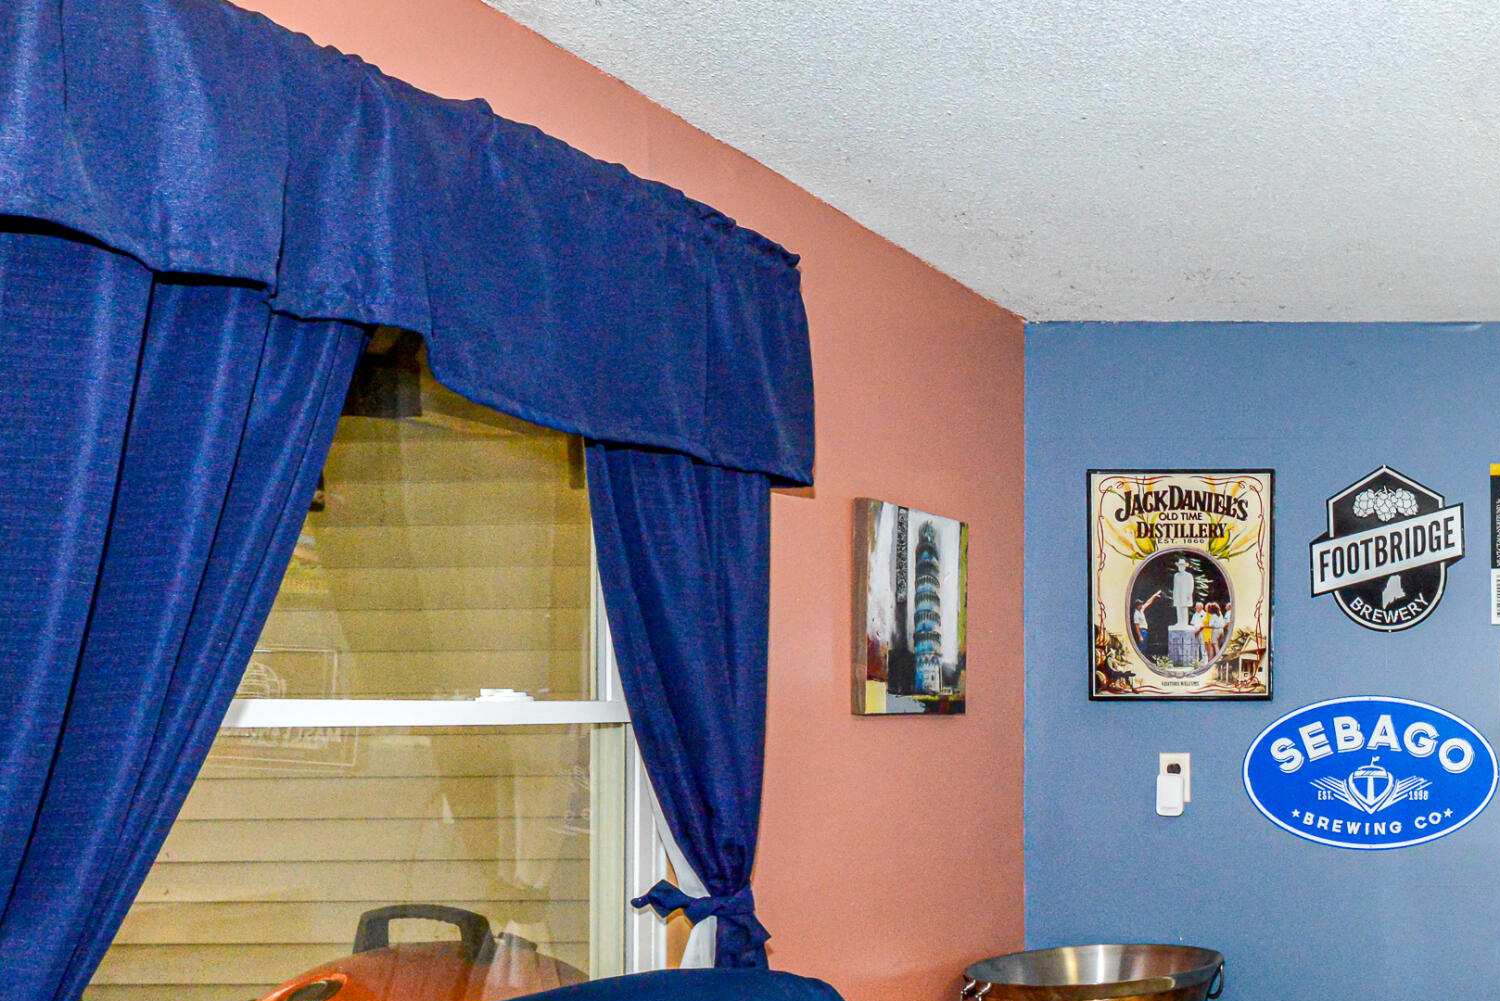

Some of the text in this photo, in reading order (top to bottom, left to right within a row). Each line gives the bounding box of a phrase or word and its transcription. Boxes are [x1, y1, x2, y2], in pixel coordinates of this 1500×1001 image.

[1115, 485, 1248, 522] JACK DANIEL'S
[1159, 512, 1202, 520] OLD TIME
[1136, 522, 1228, 538] DISTILLERY
[1320, 516, 1456, 582] FOOTBRIDGE
[1350, 592, 1429, 623] BREWERY
[1270, 714, 1475, 774] SEBAGO
[1318, 791, 1429, 801] EST. 1998
[1302, 812, 1442, 835] BREWING CO
